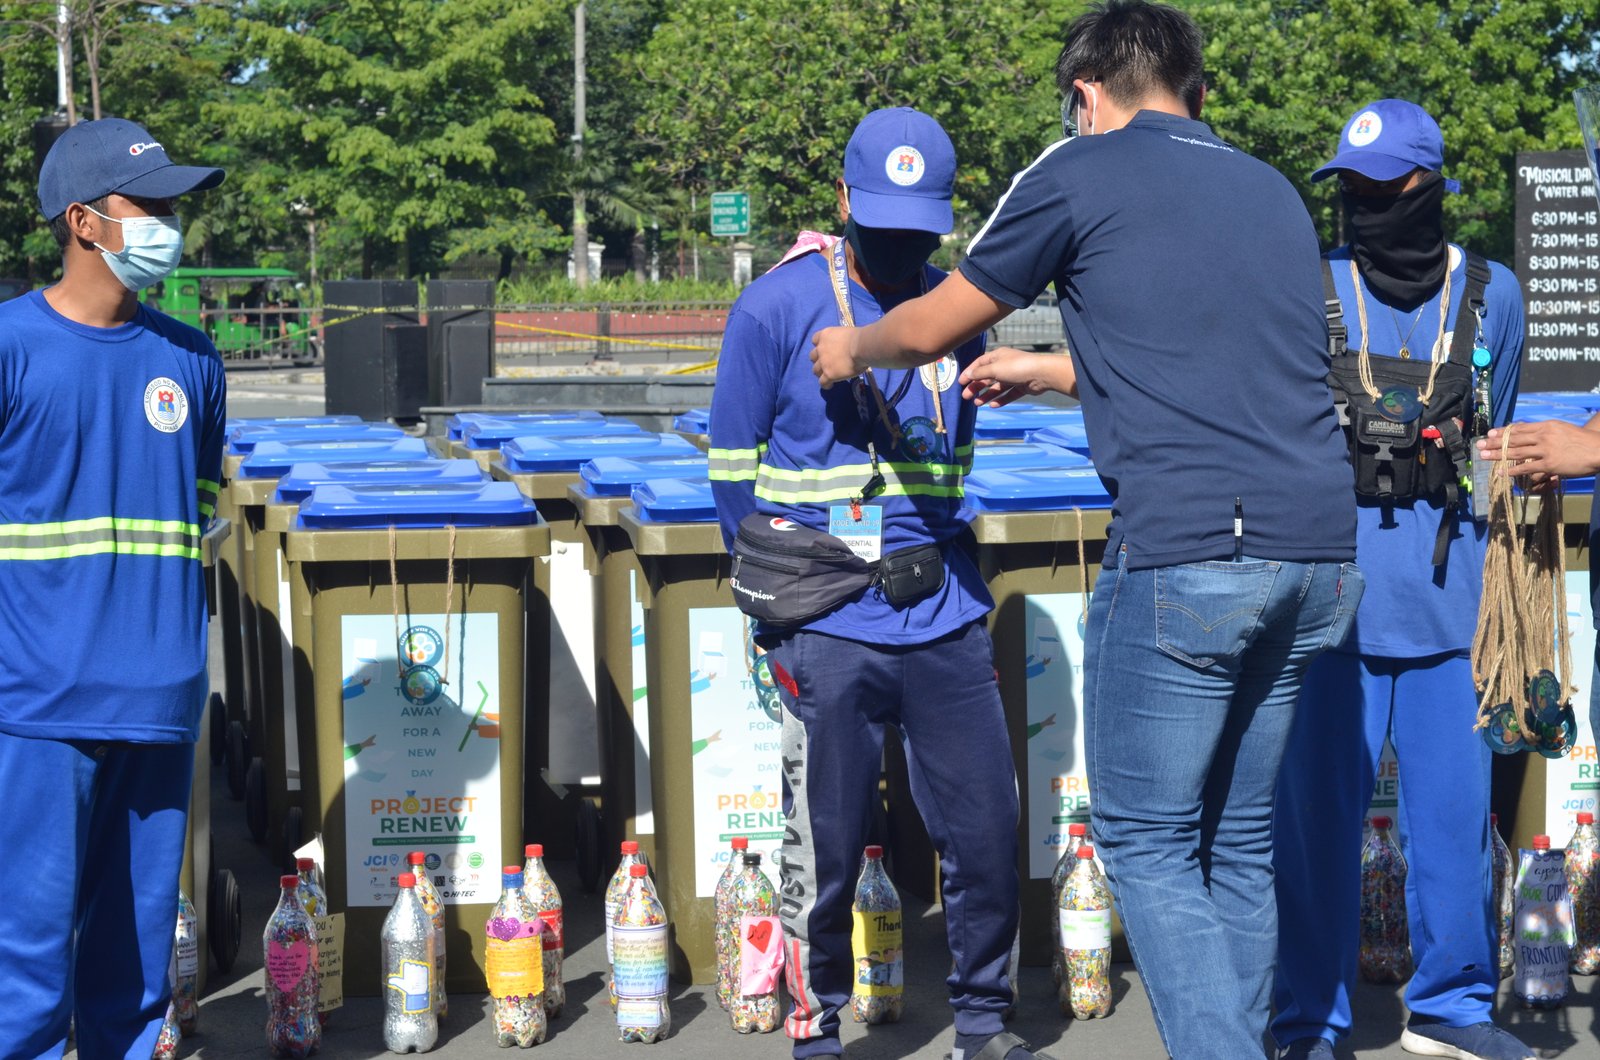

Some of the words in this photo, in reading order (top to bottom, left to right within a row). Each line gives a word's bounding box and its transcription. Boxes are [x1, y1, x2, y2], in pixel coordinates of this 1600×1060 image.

[1519, 166, 1573, 186] MUSICAL
[1535, 184, 1578, 202] (WATER
[1580, 185, 1597, 198] AN
[1531, 211, 1558, 225] 6:30
[1531, 233, 1558, 247] 7:30
[1529, 256, 1558, 270] 8:30
[1529, 278, 1559, 292] 9:30
[1528, 300, 1562, 314] 10:30
[1528, 323, 1558, 336] 11:30
[1528, 347, 1558, 361] 12:00
[854, 550, 874, 558] ONNEL
[729, 577, 776, 602] Champion
[400, 706, 442, 718] AWAY
[403, 728, 428, 737] FOR
[432, 728, 441, 737] A
[749, 721, 774, 731] FOR
[408, 748, 436, 757] NEW
[411, 769, 434, 778] DAY
[757, 763, 780, 772] DAY
[370, 796, 477, 815] PROJECT
[717, 793, 778, 810] PROJ
[1562, 799, 1584, 810] JCI
[380, 815, 468, 833] RENEW
[727, 812, 787, 829] RENE
[363, 855, 387, 867] JCI
[873, 915, 901, 932] Than
